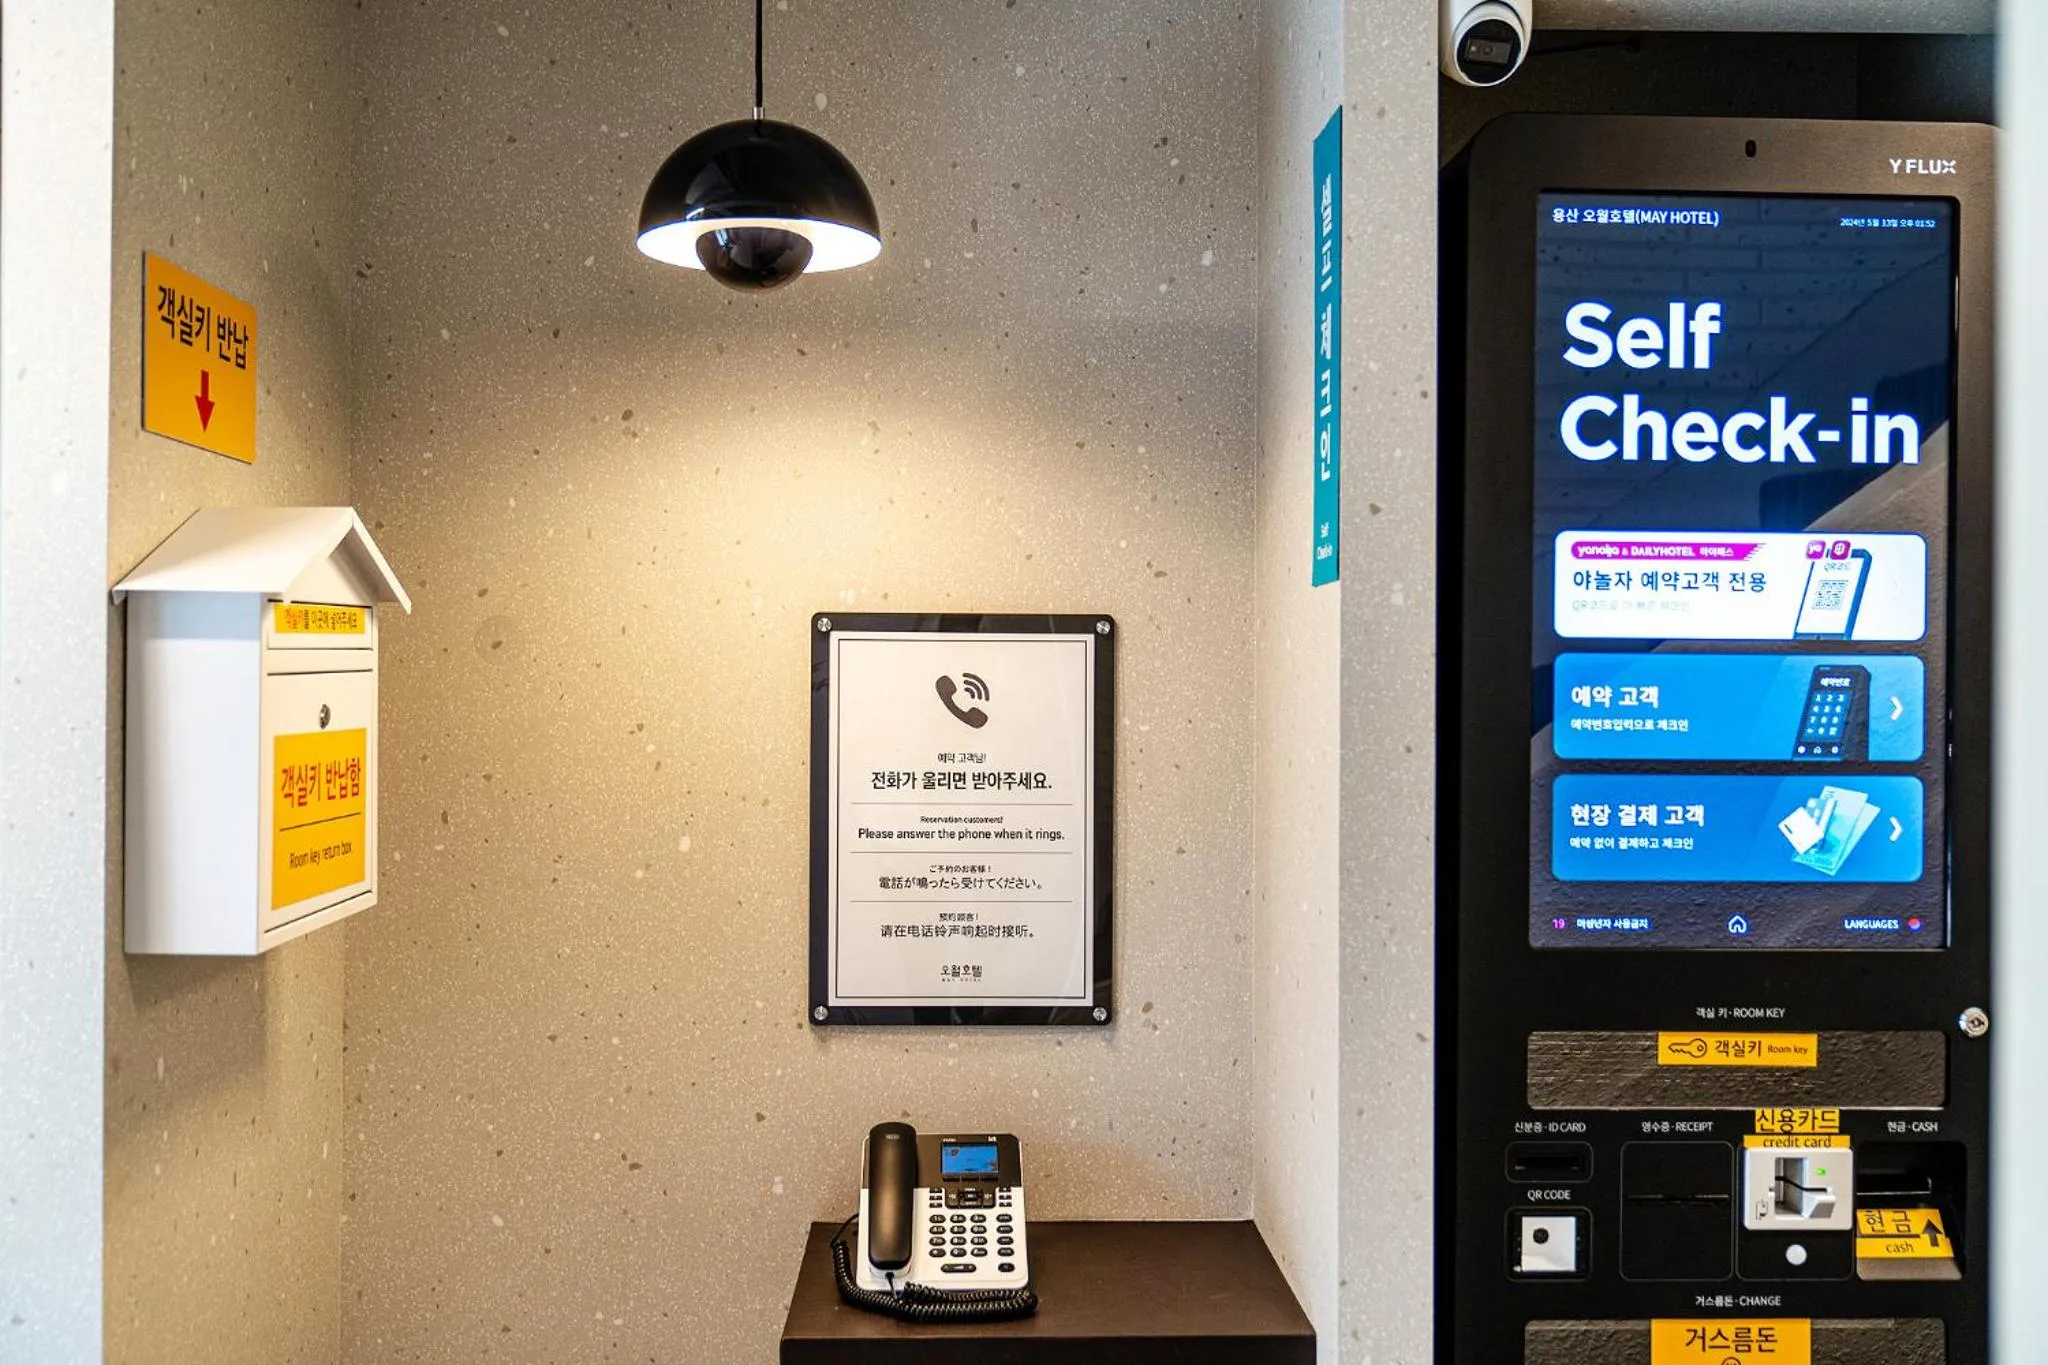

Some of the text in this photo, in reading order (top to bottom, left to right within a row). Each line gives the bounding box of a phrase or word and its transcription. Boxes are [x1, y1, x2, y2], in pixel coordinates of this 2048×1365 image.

[1889, 158, 1957, 174] Y FLUX
[1552, 208, 1720, 228] 용산 오월호텔(MAY HOTEL)
[157, 284, 249, 370] 객실키 반납
[1562, 301, 1723, 371] Self
[1559, 392, 1921, 466] Check-in
[1630, 545, 1696, 557] DAILYHOTEL
[1572, 569, 1768, 594] 야놀자 예약고객 전용
[1571, 685, 1660, 709] 예약 고객
[937, 752, 987, 764] 예약 고객님!
[281, 756, 361, 808] 객실키 반납함
[871, 771, 1053, 791] 전화가 울리면 받아주세요.
[920, 815, 1004, 824] Reservation customers!
[1570, 803, 1705, 828] 현장 결제 고객
[857, 827, 1065, 843] Please answer the phone when it rings.
[288, 850, 309, 869] Room
[878, 876, 1043, 890] 電話が鳴ったら受けてください。
[880, 924, 1035, 939] 请在电话铃声响起时接听。
[1552, 918, 1566, 930] 19
[1844, 919, 1899, 929] LANGUAGES
[1696, 1007, 1715, 1019] 객실
[1766, 1008, 1786, 1018] KEY
[1714, 1040, 1809, 1059] 객실키 Room key
[1559, 1122, 1587, 1132] CARD
[1756, 1108, 1840, 1134] 신용카드
[1762, 1136, 1832, 1148] credit card
[1527, 1189, 1572, 1201] QR CODE
[1886, 1241, 1915, 1254] cash
[1685, 1326, 1778, 1353] 거스름돈
